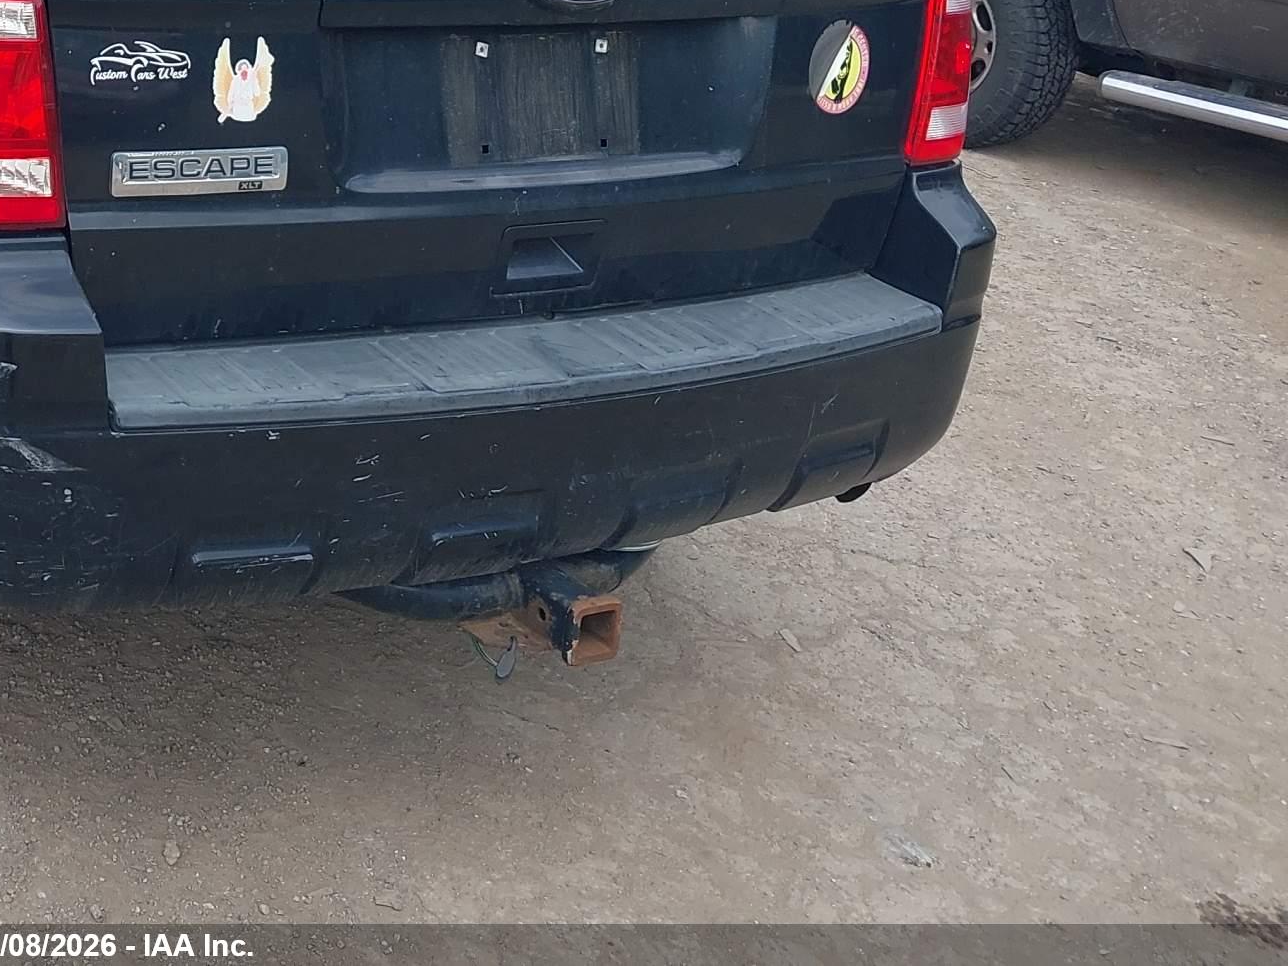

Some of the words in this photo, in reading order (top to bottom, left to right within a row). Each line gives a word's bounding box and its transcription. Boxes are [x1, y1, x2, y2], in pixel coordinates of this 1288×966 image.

[90, 65, 128, 85] Custom
[130, 64, 155, 82] Cars
[158, 67, 187, 80] West
[128, 155, 274, 180] ESCAPE
[239, 181, 262, 190] XLT
